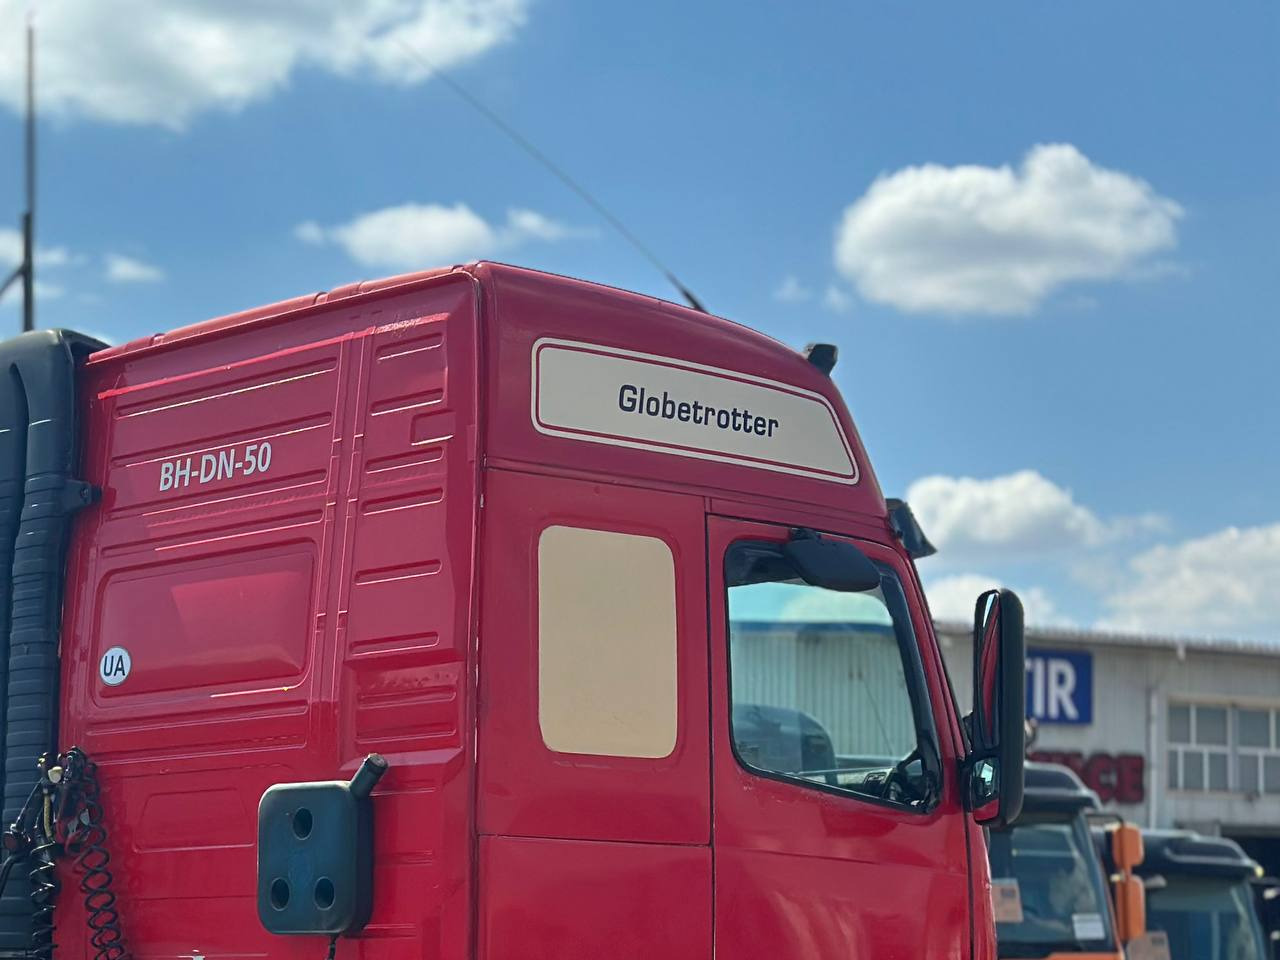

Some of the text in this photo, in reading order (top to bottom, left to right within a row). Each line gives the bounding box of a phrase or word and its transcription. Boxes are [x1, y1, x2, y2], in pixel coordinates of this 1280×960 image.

[618, 384, 779, 437] Globetrotter
[159, 442, 272, 491] BH-DN-50
[103, 655, 126, 677] UA
